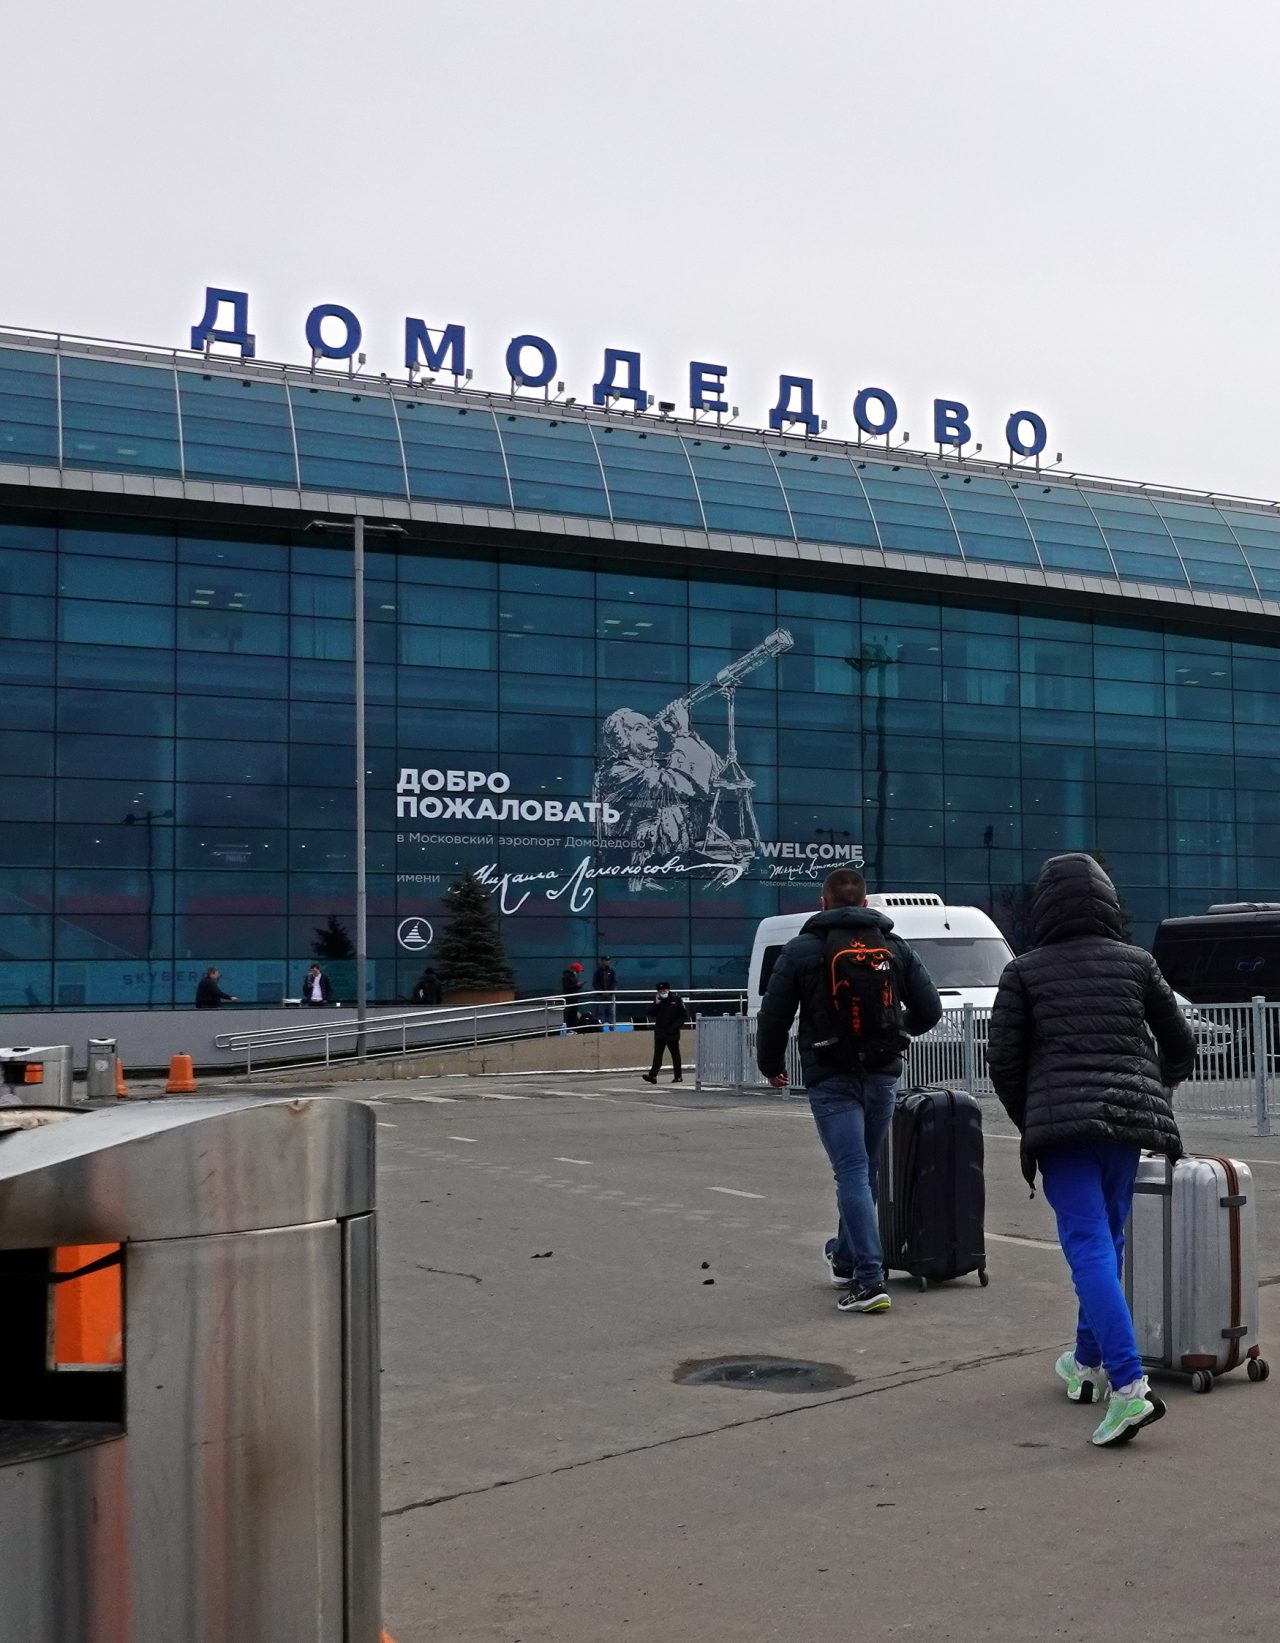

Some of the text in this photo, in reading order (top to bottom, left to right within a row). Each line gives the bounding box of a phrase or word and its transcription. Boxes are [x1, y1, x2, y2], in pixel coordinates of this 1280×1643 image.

[190, 286, 1047, 457] ДОМОДЕДОВО
[397, 768, 511, 794] ДОБРО
[396, 796, 621, 824] ПОЖАЛОВАТЬ
[397, 832, 647, 849] в Московский аэропорт Домодедово
[760, 841, 863, 860] WELCOME
[396, 874, 441, 883] имени
[546, 855, 744, 913] Ломоносова
[122, 971, 207, 985] SKYBER
